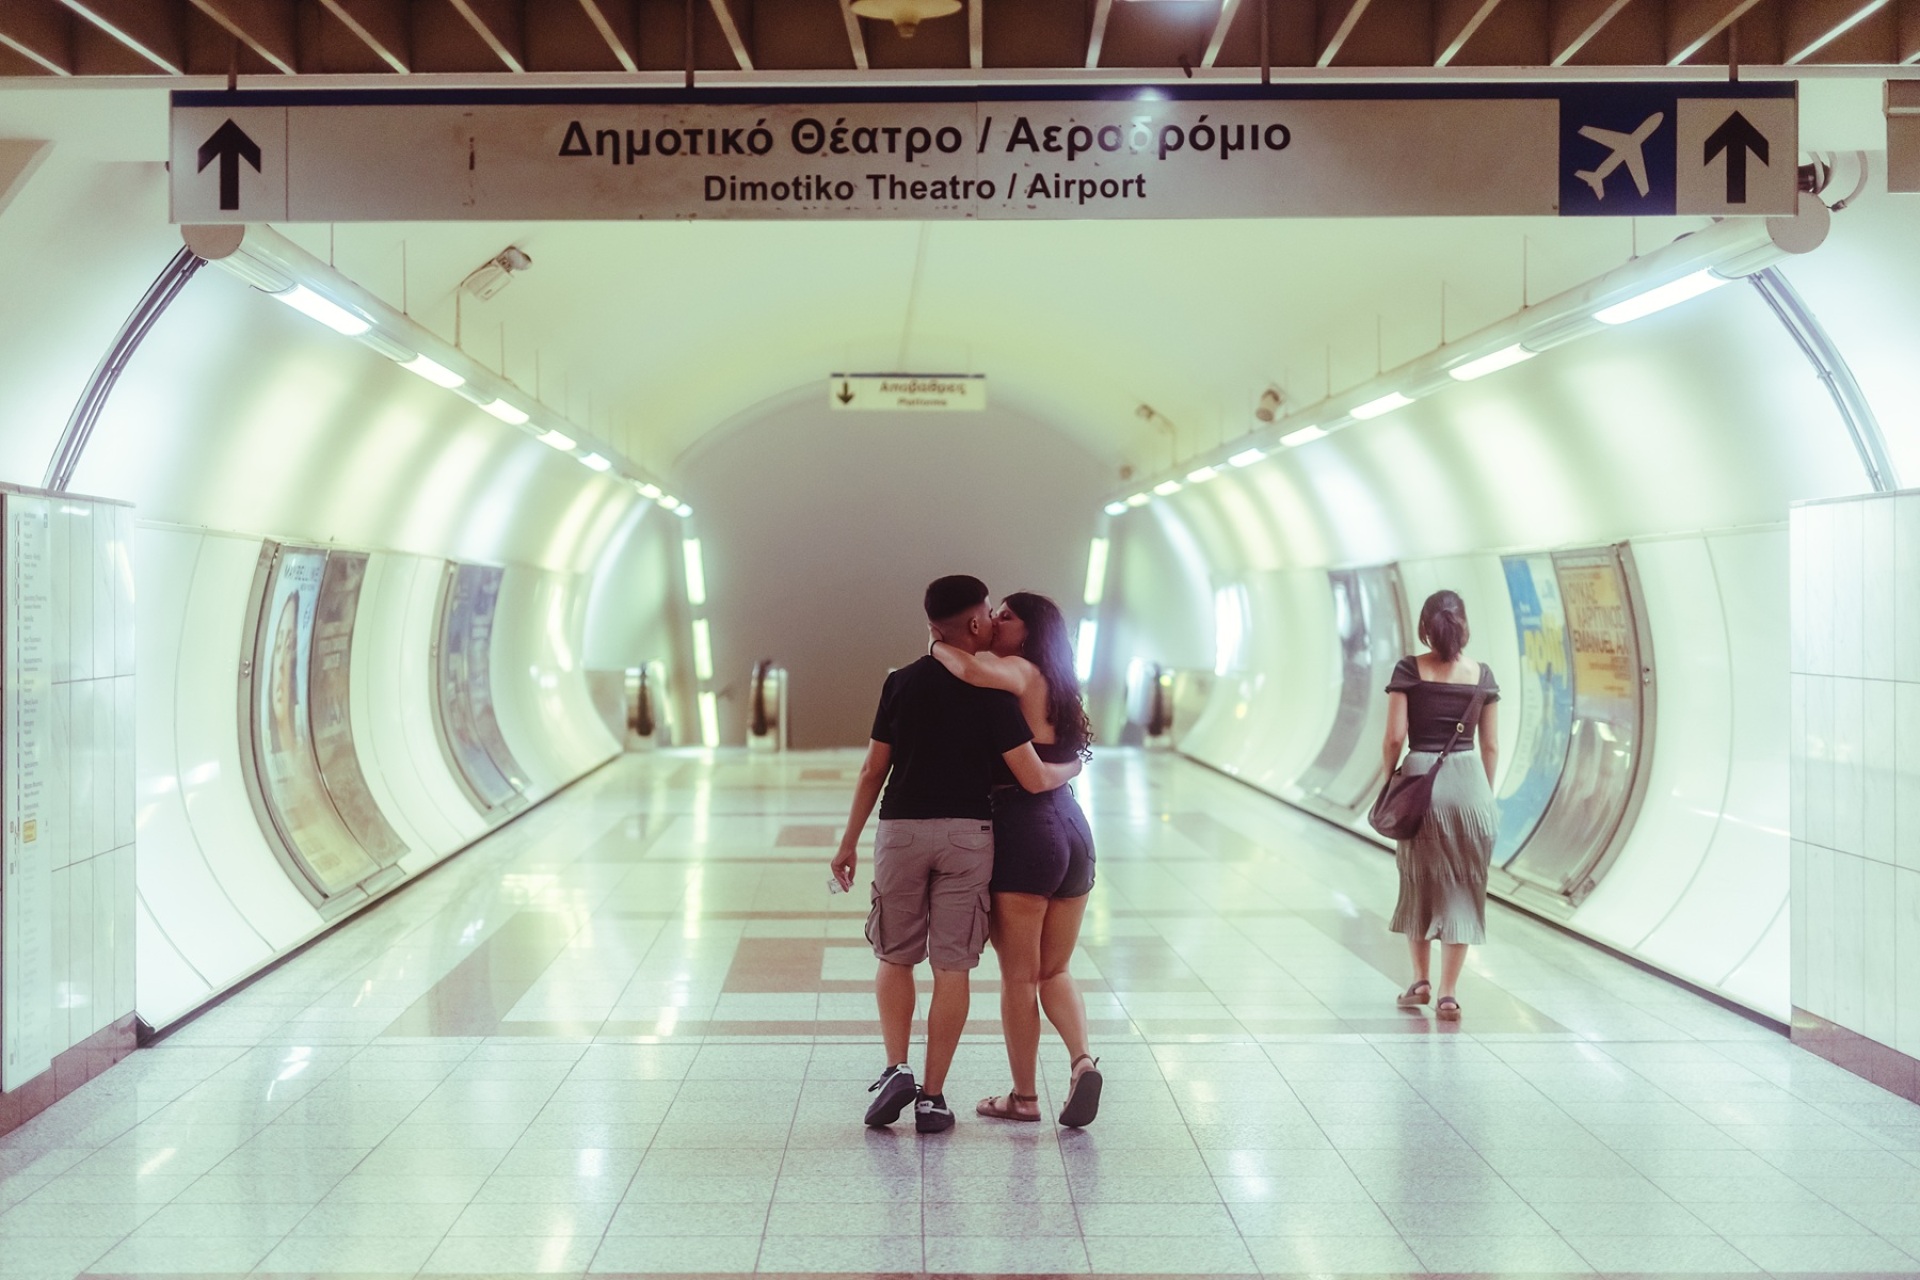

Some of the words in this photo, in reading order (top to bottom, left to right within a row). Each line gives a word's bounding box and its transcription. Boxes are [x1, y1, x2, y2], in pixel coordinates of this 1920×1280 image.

[558, 118, 773, 165] Δημοτικό
[791, 118, 962, 163] Θέατρο
[976, 116, 992, 153] /
[1005, 115, 1291, 161] Αεροδρόμιο
[704, 175, 854, 201] Dimotiko
[866, 174, 996, 201] Theatro
[1007, 173, 1017, 199] /
[1026, 173, 1146, 205] Airport
